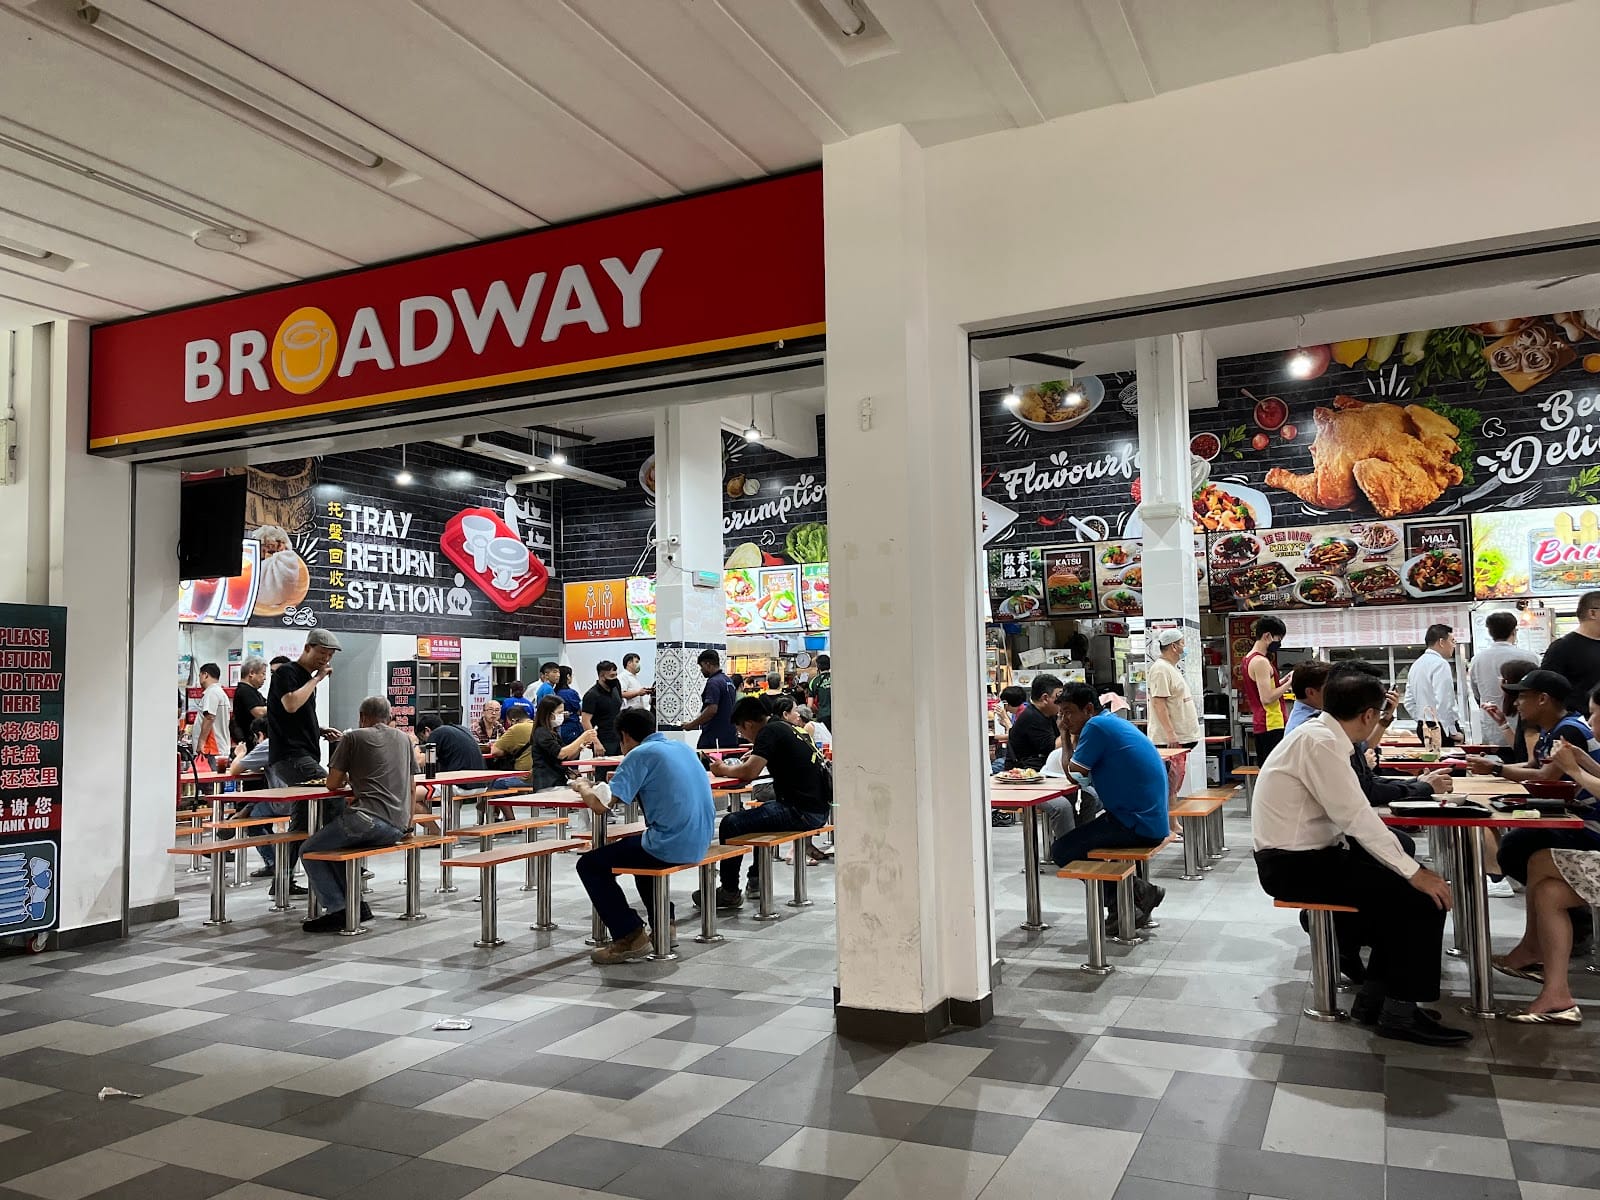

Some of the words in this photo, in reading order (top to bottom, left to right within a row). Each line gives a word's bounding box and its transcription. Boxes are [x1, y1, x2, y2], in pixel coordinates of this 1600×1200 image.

[1496, 424, 1600, 484] Deli
[999, 443, 1141, 501] Flavourf
[722, 480, 828, 534] crumptio
[346, 503, 413, 539] TRAY
[1422, 533, 1455, 544] MALA
[346, 541, 435, 578] RETURN
[1055, 558, 1082, 566] KATSU
[347, 581, 444, 614] STATION
[574, 618, 625, 631] WASHROOM
[24, 672, 62, 691] TRAY
[2, 694, 41, 713] HERE
[0, 721, 59, 742] 将您的
[1, 744, 41, 766] 托盘
[0, 796, 52, 817] 谢您
[27, 816, 50, 830] YOU
